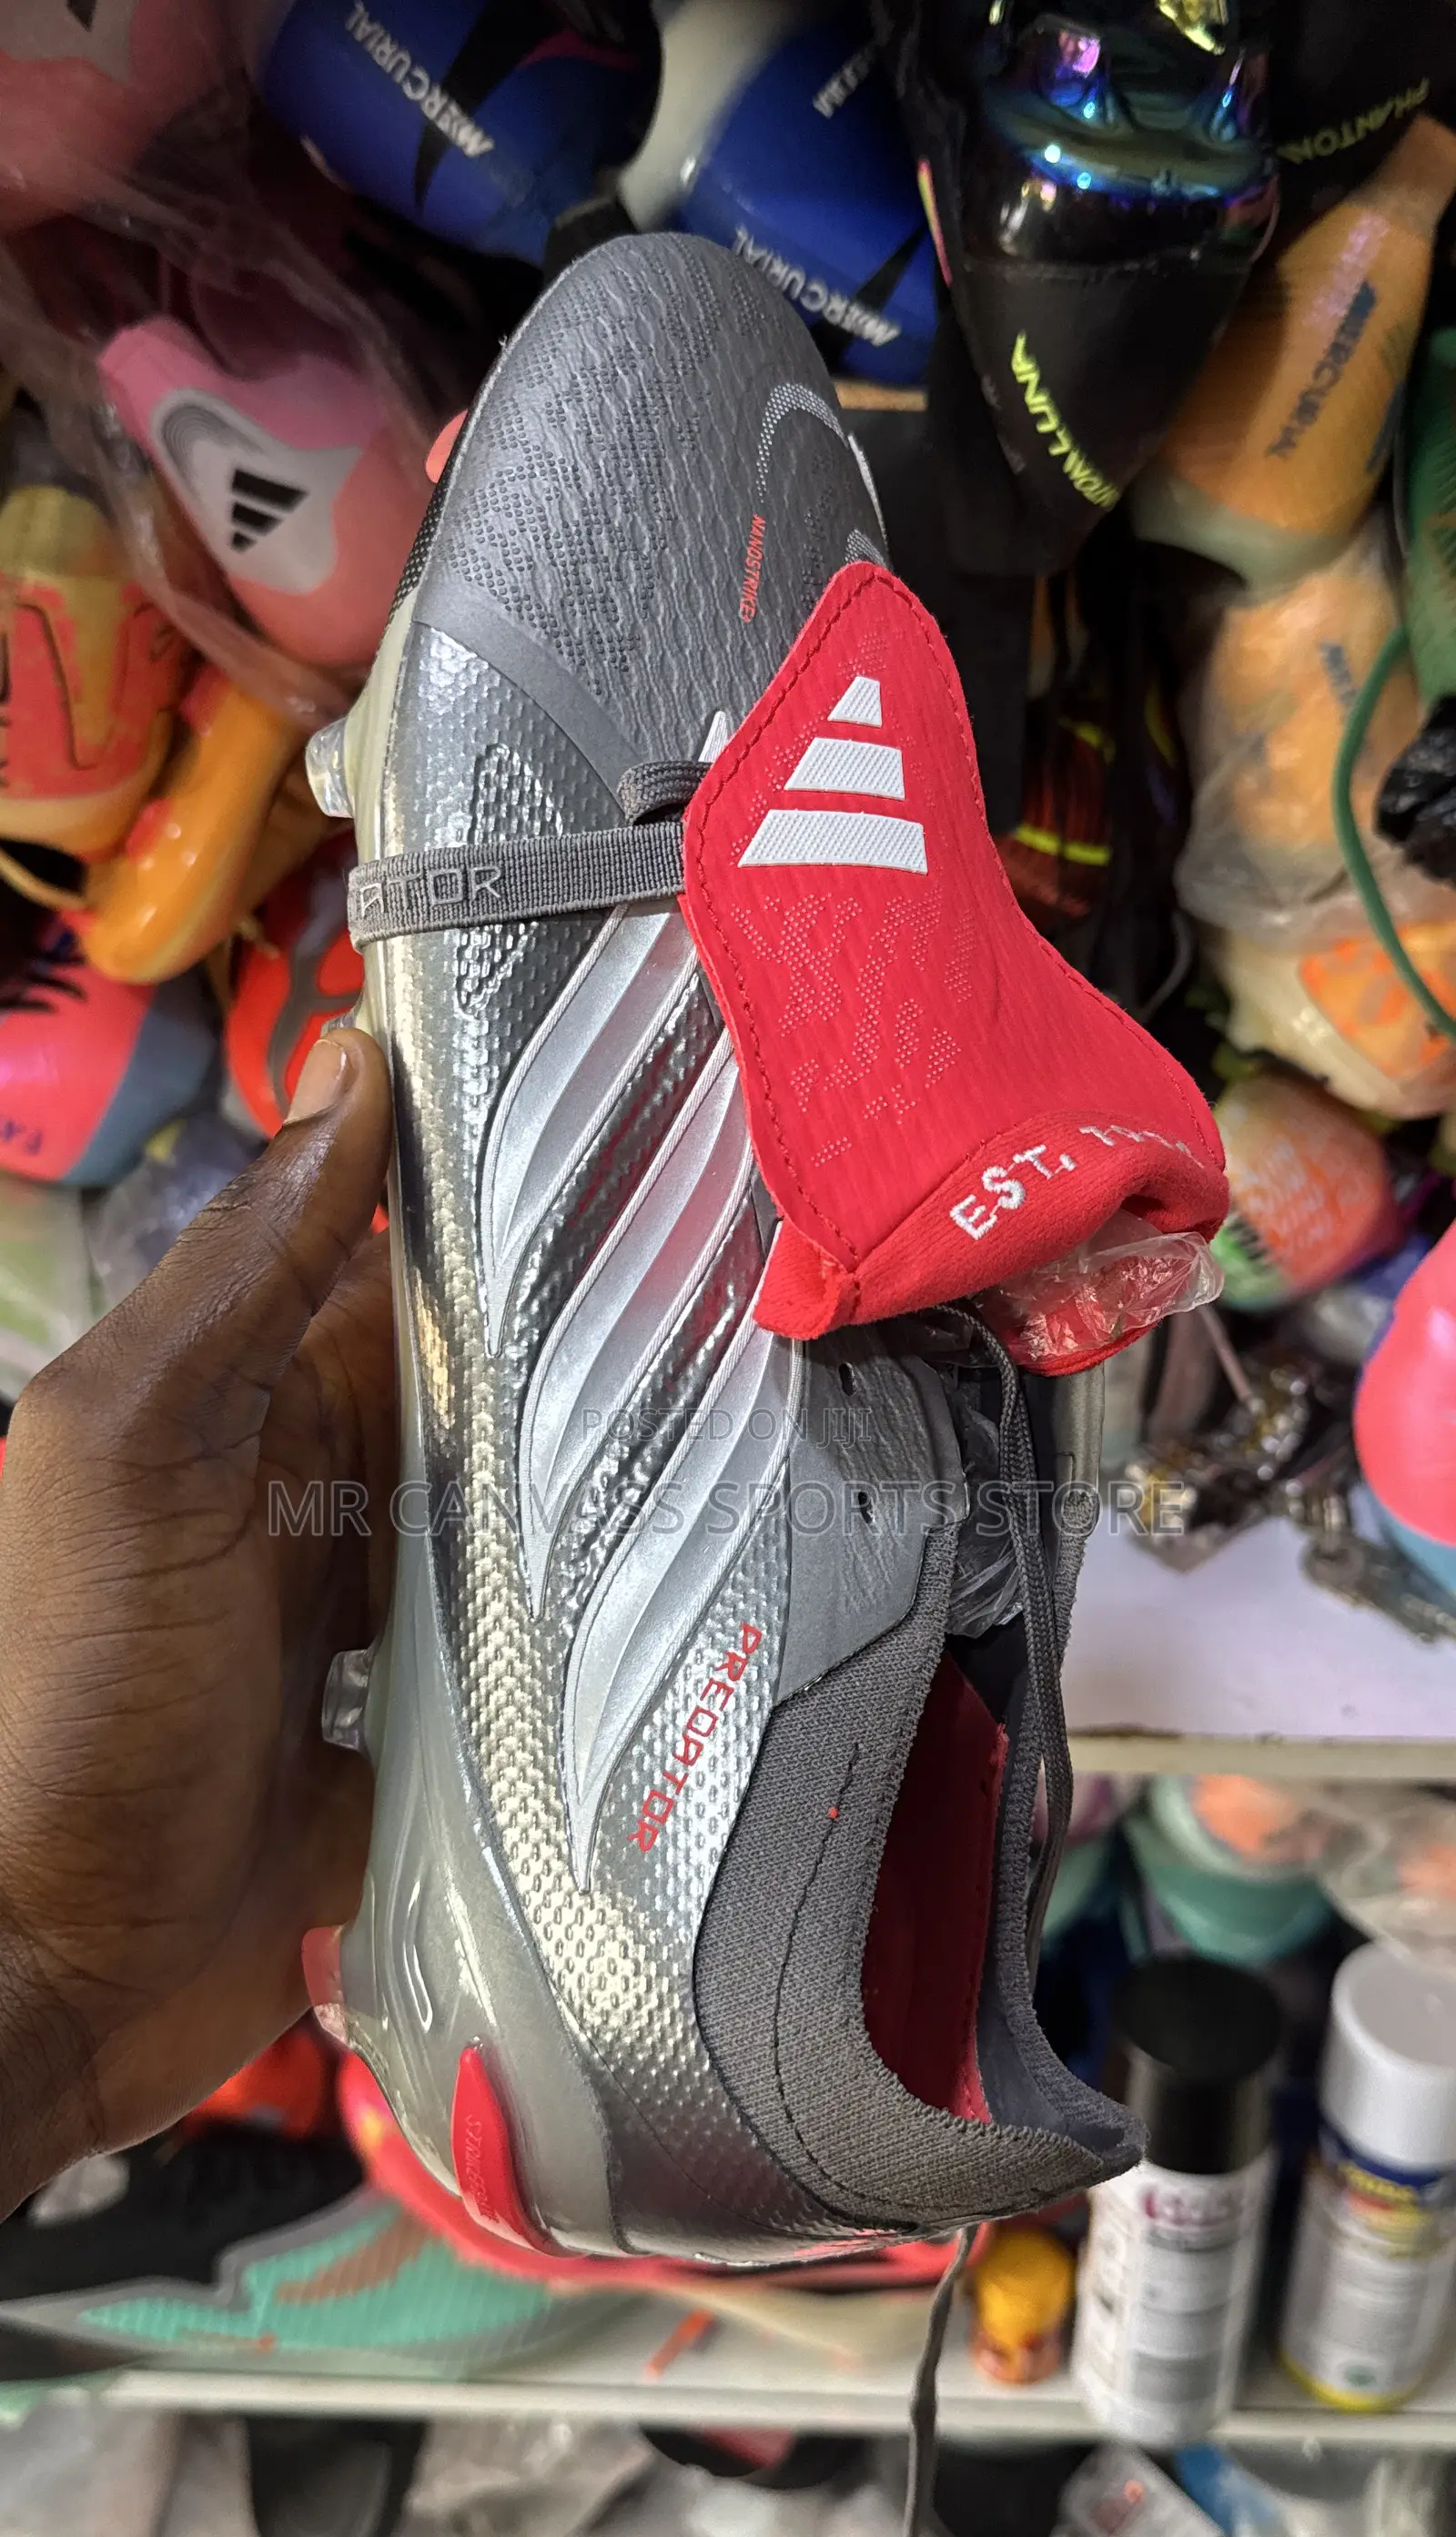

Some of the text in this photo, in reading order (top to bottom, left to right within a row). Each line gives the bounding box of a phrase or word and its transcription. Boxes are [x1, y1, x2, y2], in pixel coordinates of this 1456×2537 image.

[345, 2, 494, 158] MERCURIAL
[733, 225, 900, 347] MERCURIAL
[1012, 333, 1072, 455] LUNA
[360, 865, 501, 916] ATOR
[949, 1144, 1077, 1240] EST.
[626, 1620, 763, 1853] PREDATOR
